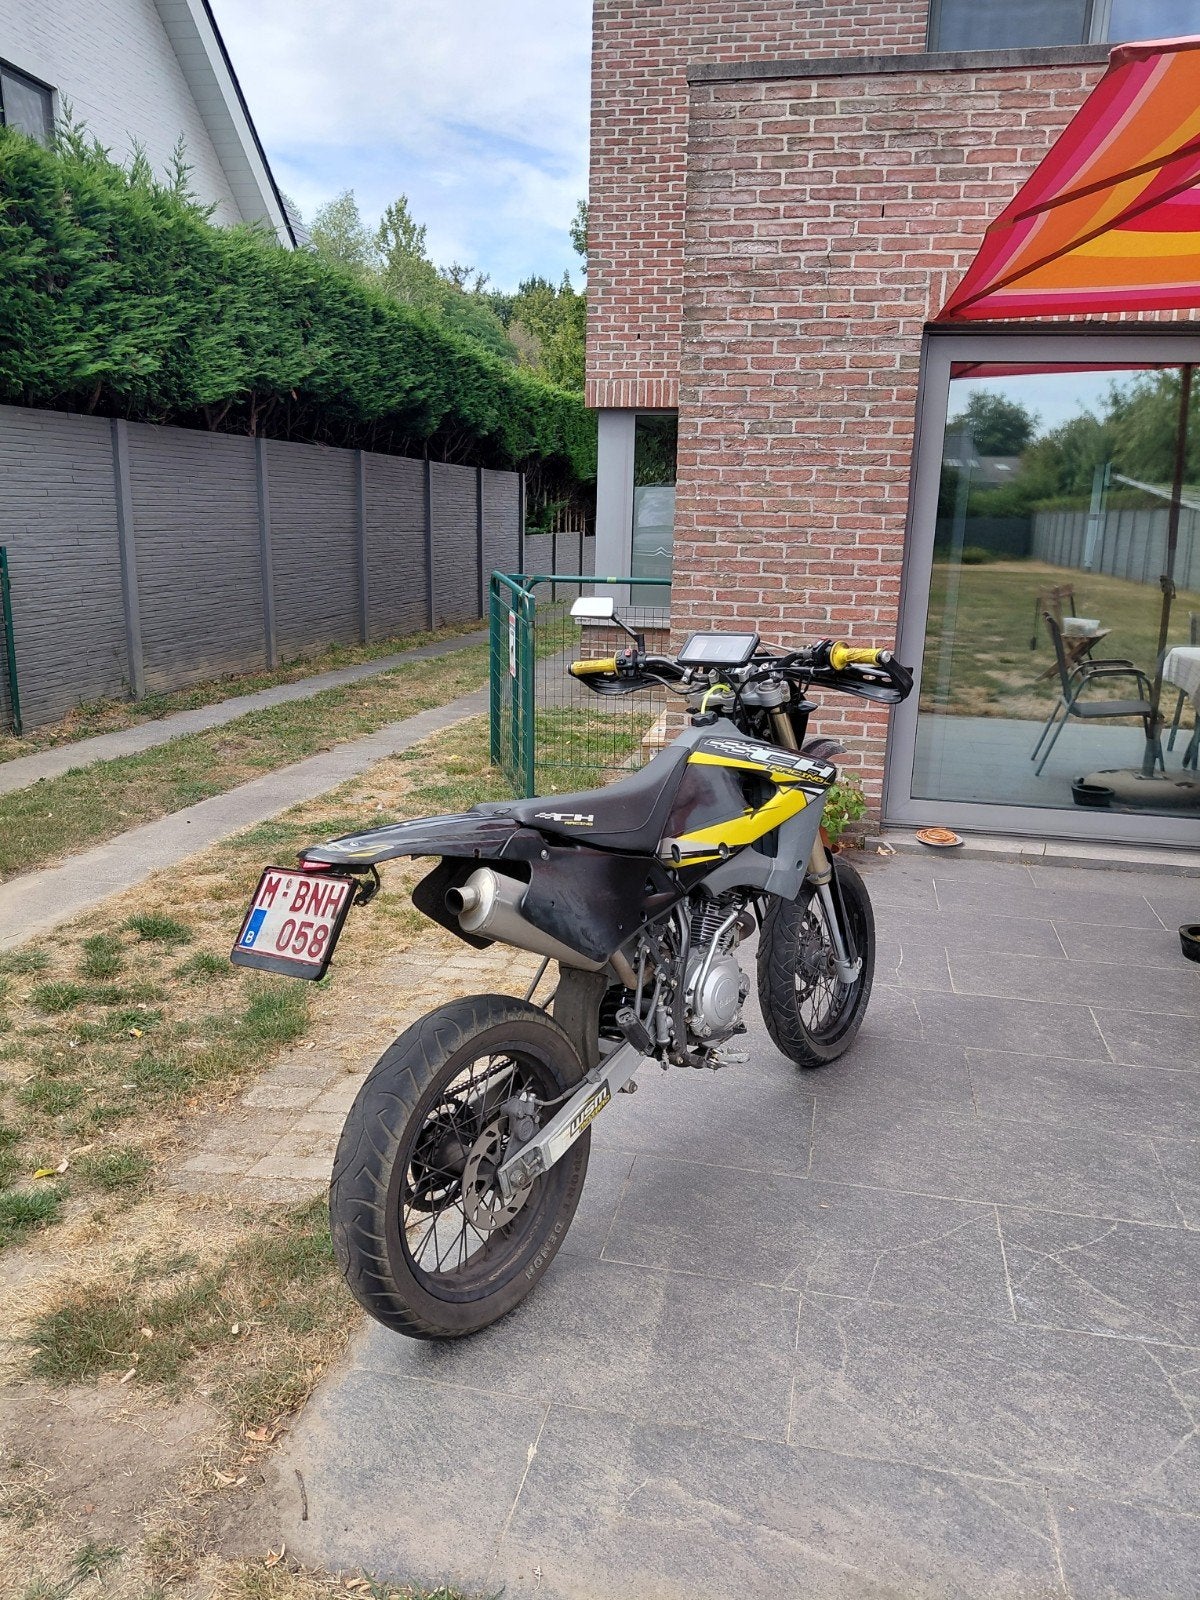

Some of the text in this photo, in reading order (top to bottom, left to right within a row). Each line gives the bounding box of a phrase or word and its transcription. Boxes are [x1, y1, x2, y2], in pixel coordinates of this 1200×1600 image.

[768, 764, 825, 784] RACING
[244, 930, 255, 943] B
[275, 918, 329, 958] 058
